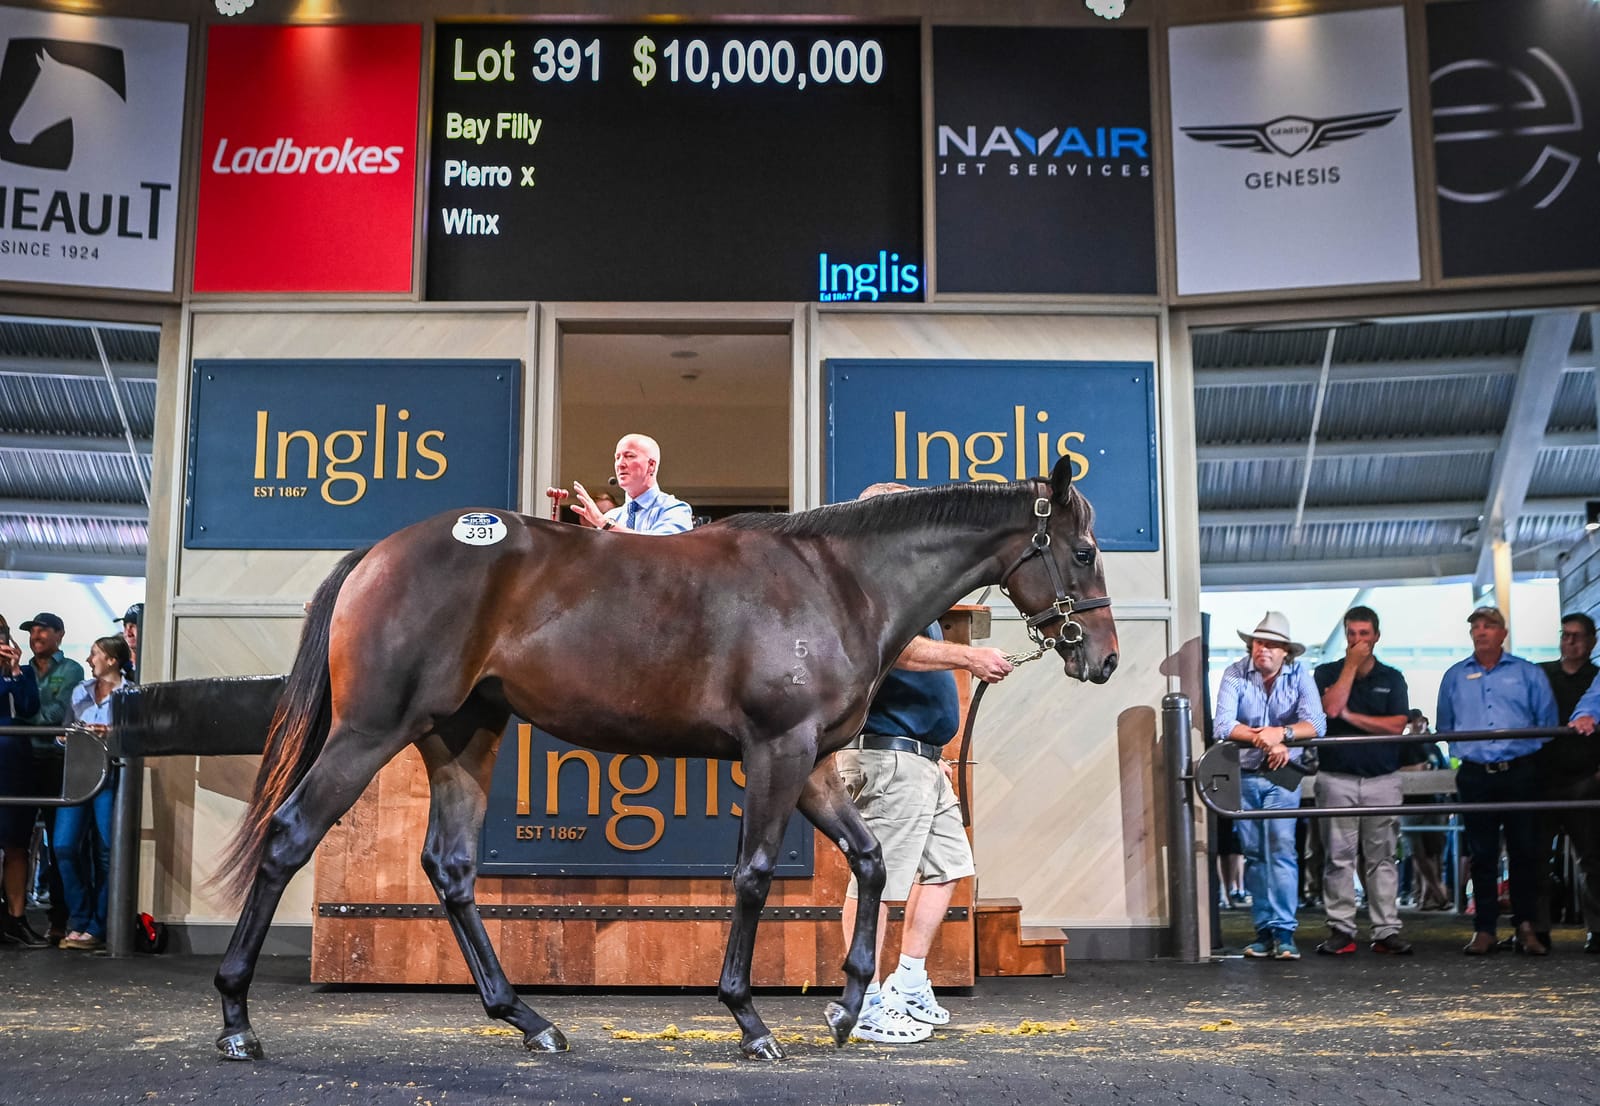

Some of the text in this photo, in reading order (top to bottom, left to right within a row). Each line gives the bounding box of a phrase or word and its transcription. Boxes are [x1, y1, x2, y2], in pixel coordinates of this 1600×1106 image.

[453, 35, 885, 90] Lot 391 $10,000,000
[446, 112, 542, 145] Bay Filly
[938, 125, 1149, 158] NAVAIR
[211, 138, 403, 175] Ladbrokes
[939, 163, 1150, 177] JET SERVICES
[444, 160, 535, 187] Pierro x
[1245, 166, 1340, 190] GENESIS
[442, 208, 500, 235] Winx
[0, 240, 99, 260] SINCE 1924
[819, 250, 920, 302] Inglis
[254, 404, 449, 506] Inglis
[894, 405, 1090, 483] Inglis
[254, 486, 308, 498] EST 1867
[465, 527, 494, 540] 391
[794, 639, 809, 659] 5
[516, 826, 587, 840] EST 1867
